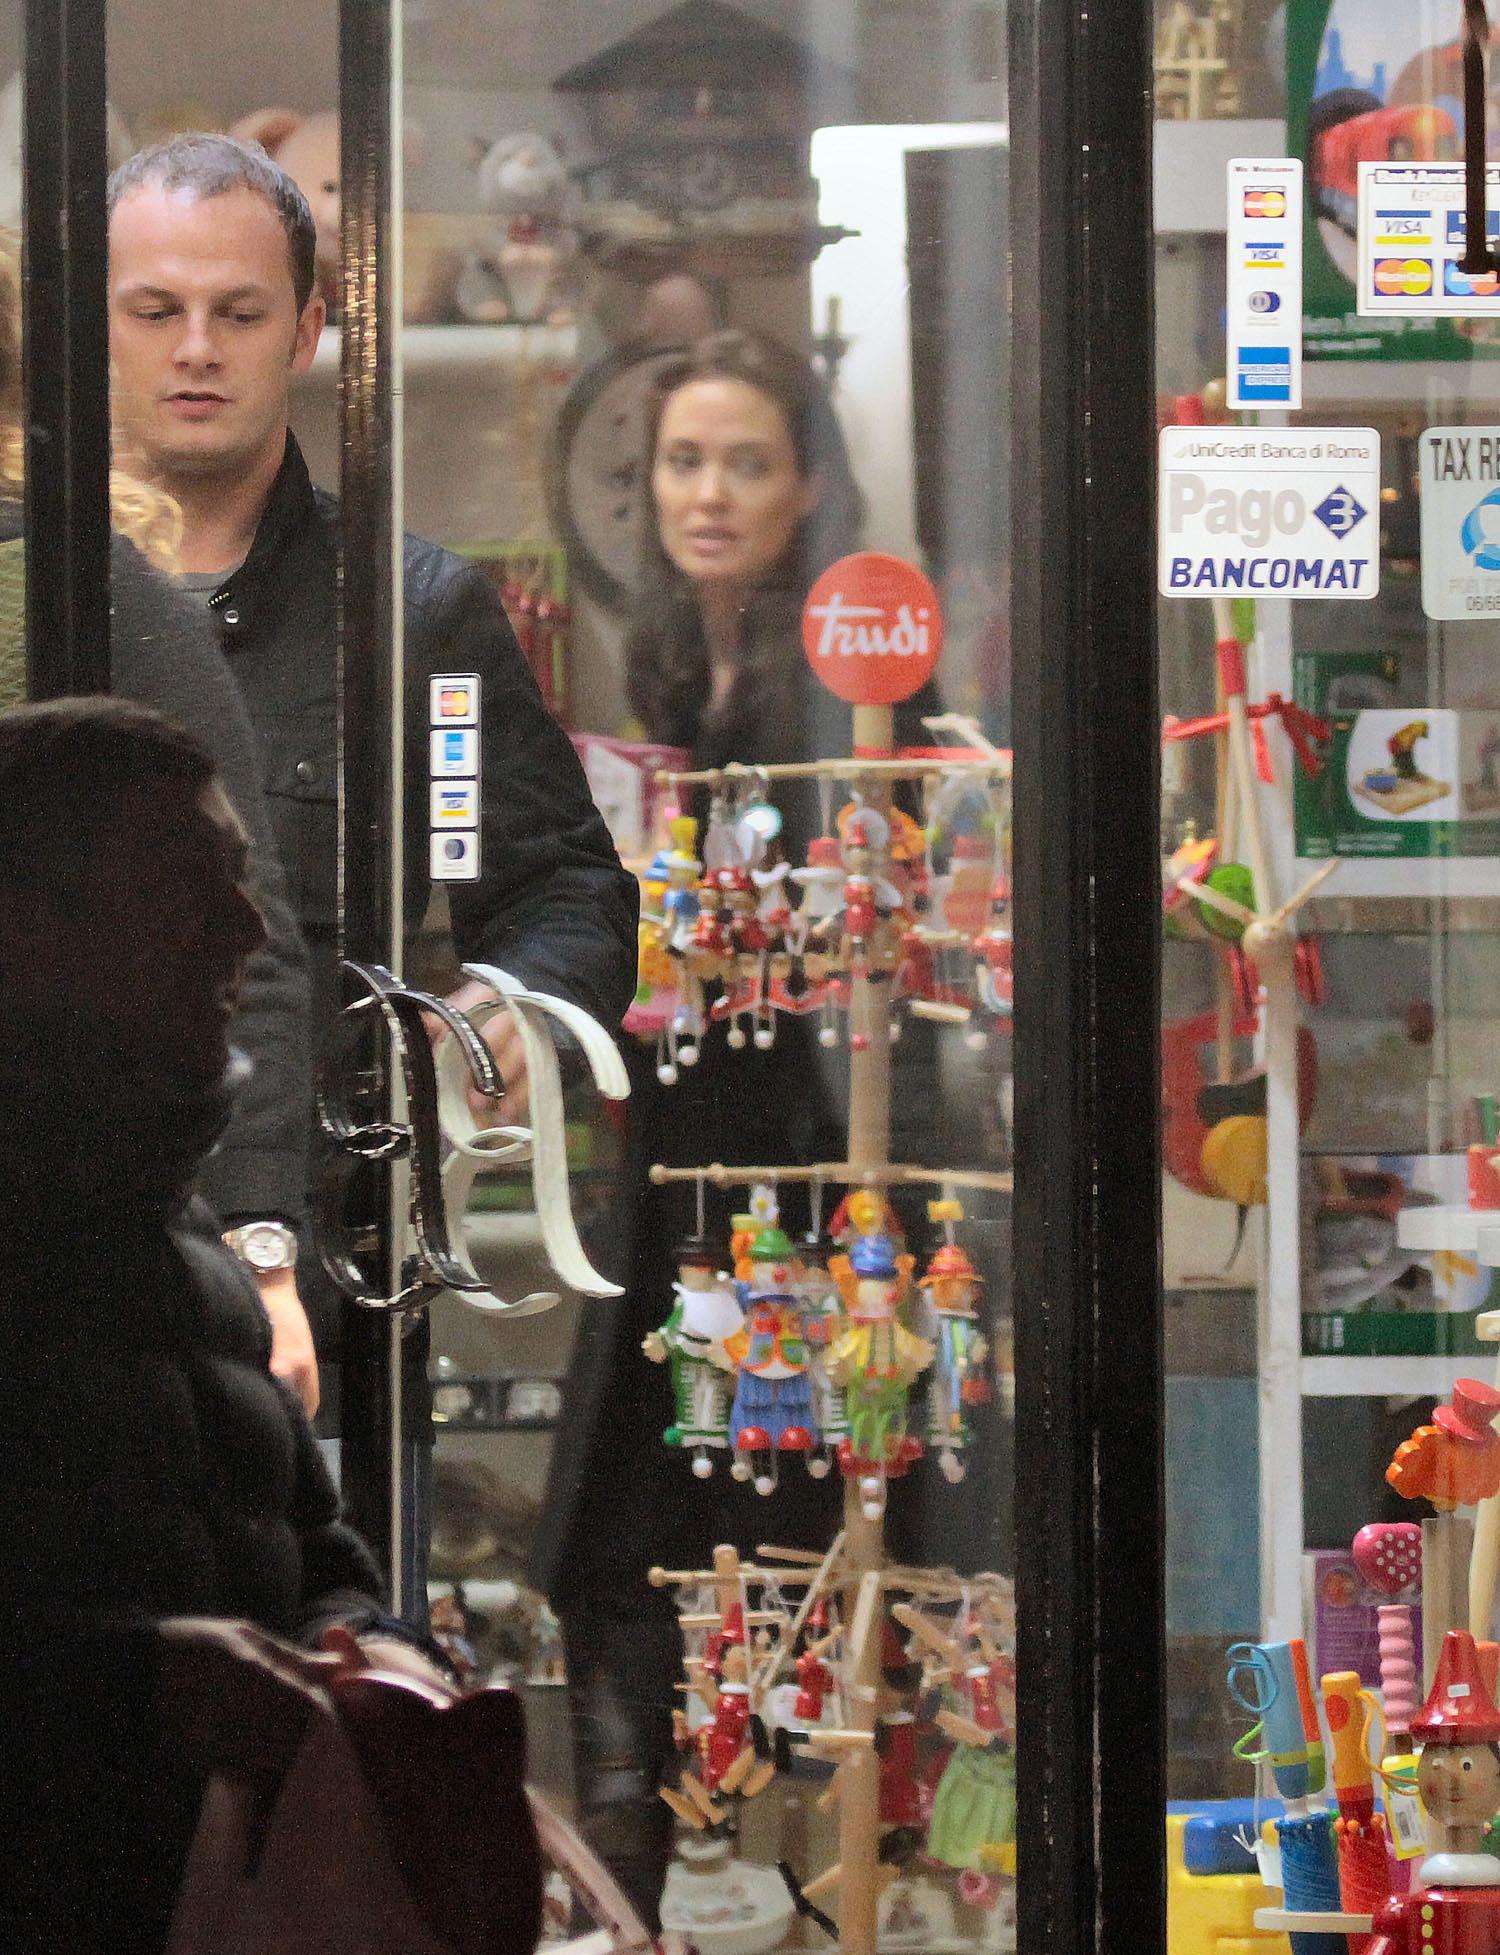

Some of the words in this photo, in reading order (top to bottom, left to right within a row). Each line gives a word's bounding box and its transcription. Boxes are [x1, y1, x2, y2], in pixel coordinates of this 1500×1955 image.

[1385, 220, 1423, 234] VISA
[1190, 443, 1257, 458] UniCredit
[1261, 443, 1307, 459] Banca
[1310, 444, 1323, 459] di
[1327, 444, 1370, 459] Roma
[1430, 437, 1471, 481] TAX
[1169, 473, 1306, 549] Pago
[1169, 557, 1369, 589] BANCOMAT
